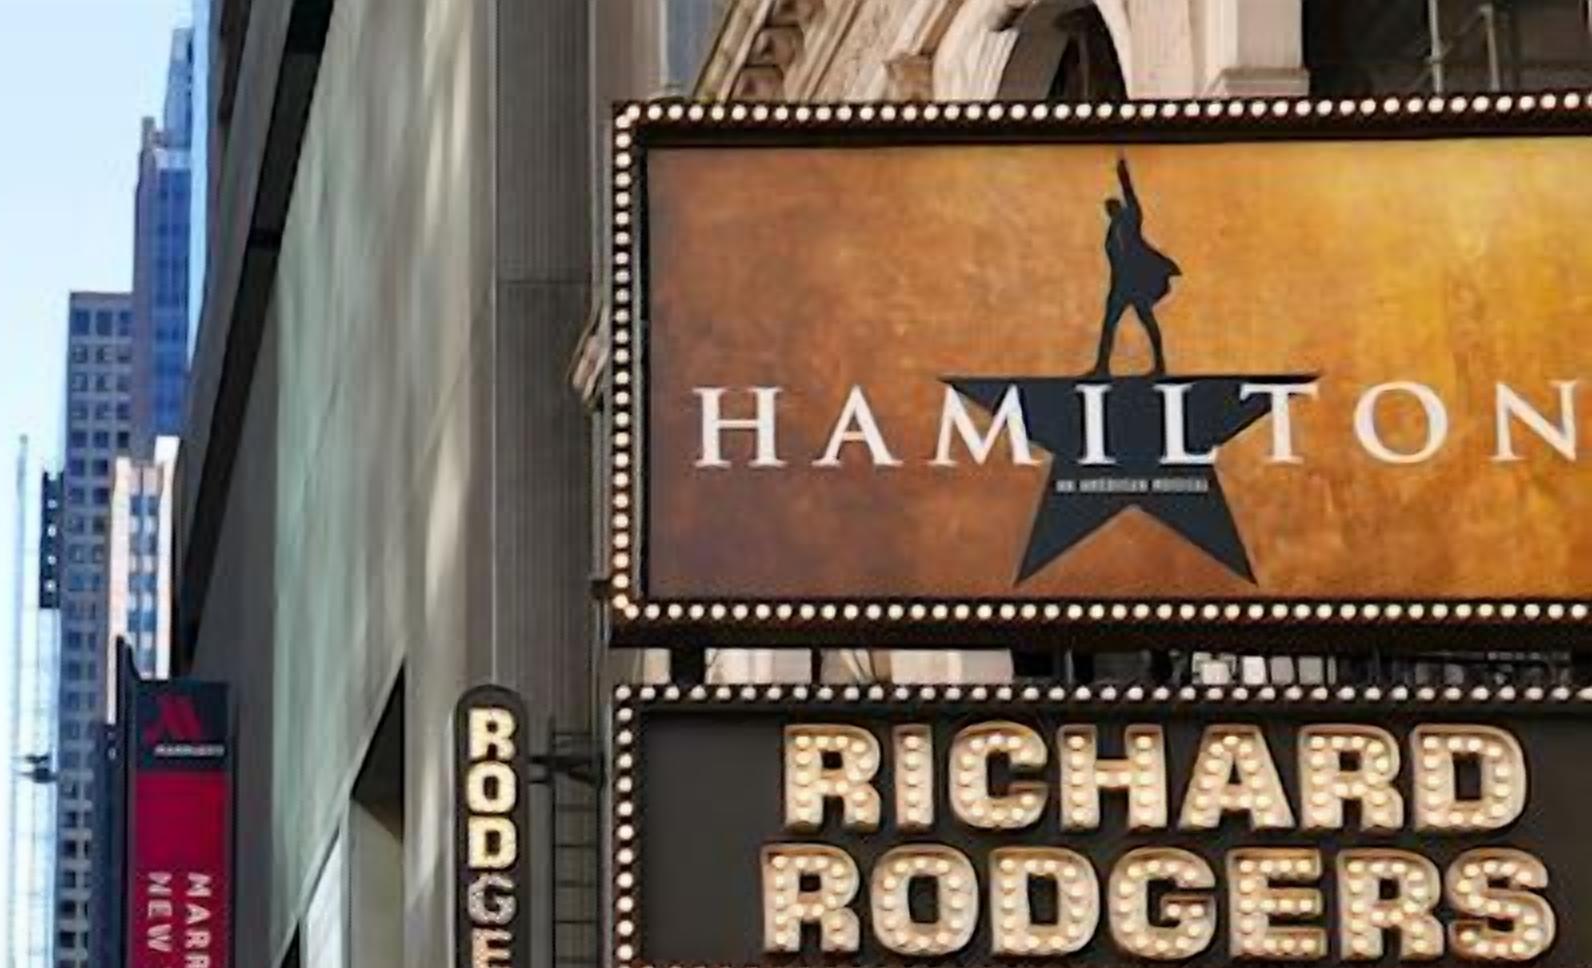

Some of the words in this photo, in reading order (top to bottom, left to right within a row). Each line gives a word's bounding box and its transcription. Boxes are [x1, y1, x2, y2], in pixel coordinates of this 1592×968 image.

[692, 379, 1576, 469] HAMILTON
[783, 722, 1528, 834] RICHARD
[147, 871, 173, 961] NEW
[760, 844, 1558, 961] RODGERS
